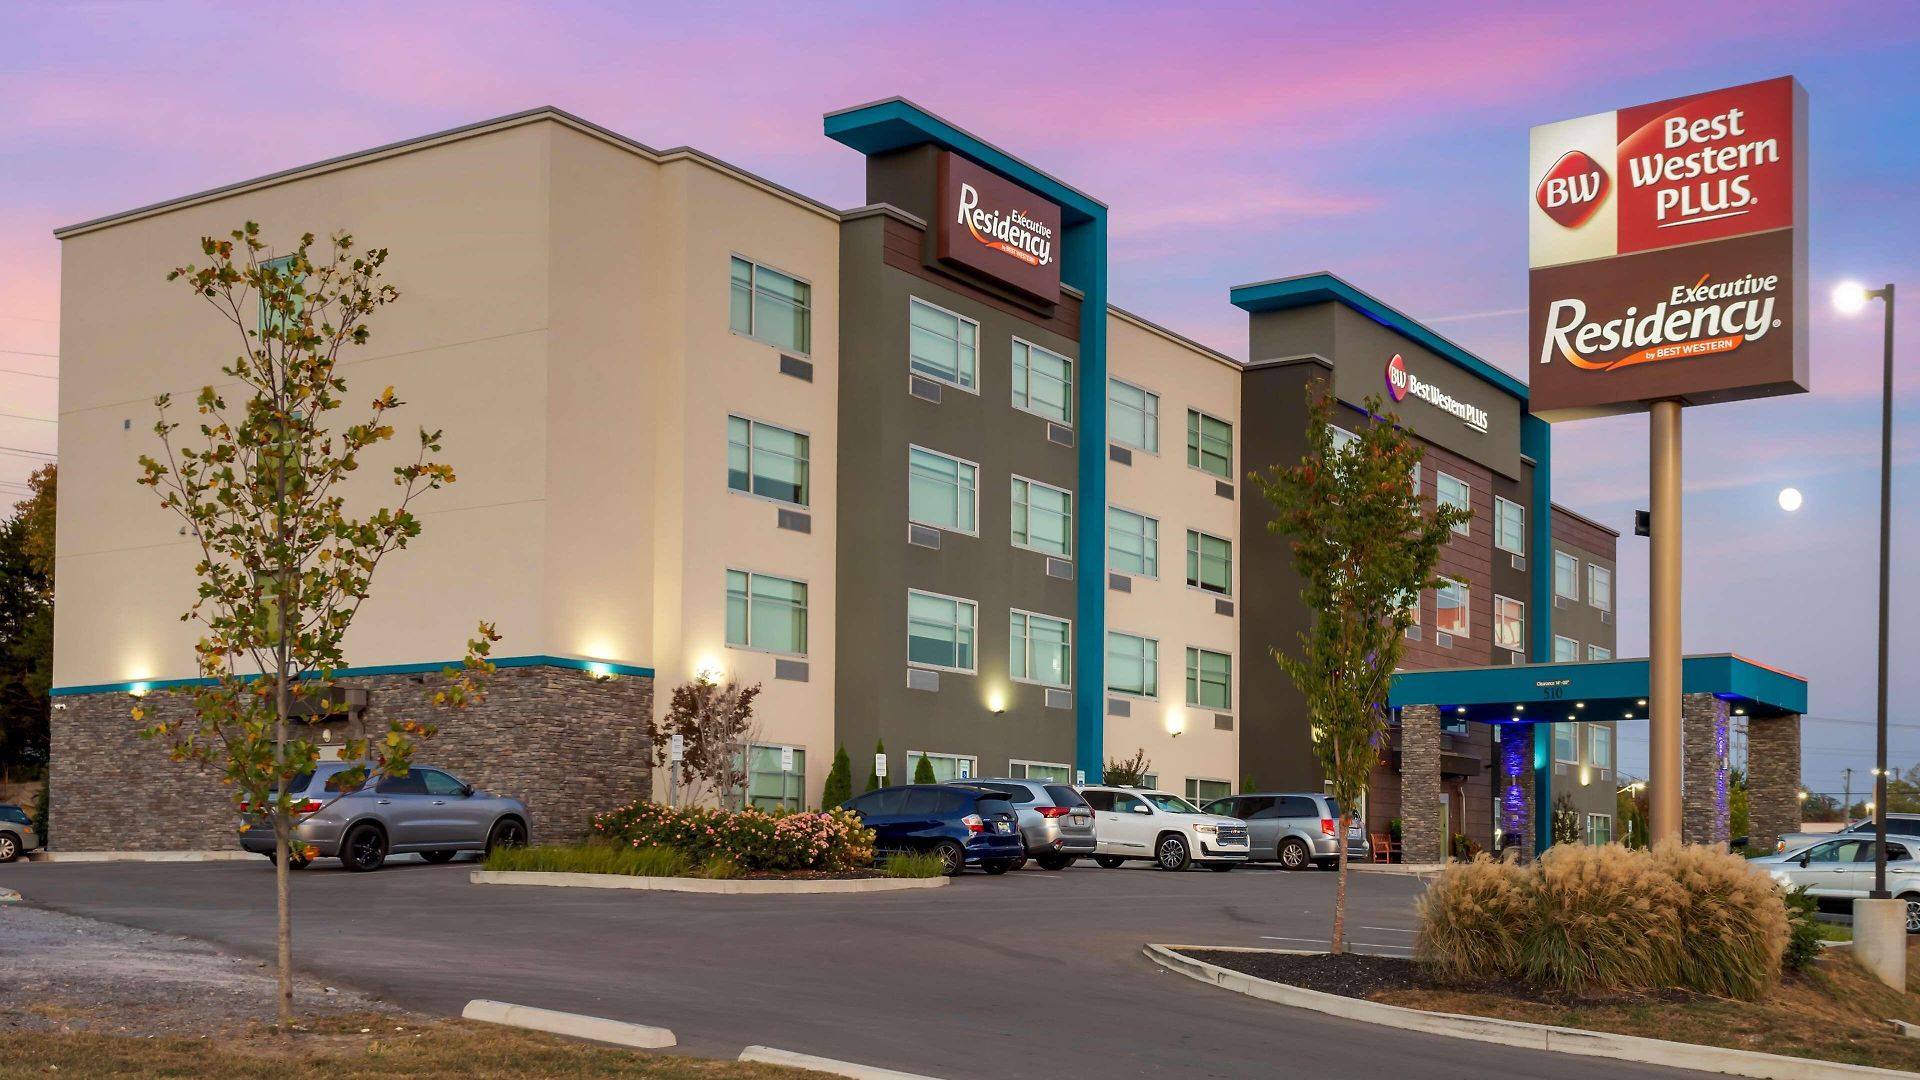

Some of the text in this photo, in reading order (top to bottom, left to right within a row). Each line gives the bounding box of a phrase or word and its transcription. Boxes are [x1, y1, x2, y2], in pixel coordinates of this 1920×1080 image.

[1664, 108, 1744, 149] Best
[1629, 138, 1779, 187] Western
[1546, 171, 1599, 208] BW
[1012, 209, 1051, 239] Executive
[1670, 274, 1778, 305] Executive
[1645, 339, 1733, 360] by BEST WESTERN
[1390, 366, 1406, 388] BW
[1408, 374, 1488, 429] Best Western PLUS
[1543, 687, 1563, 699] 510
